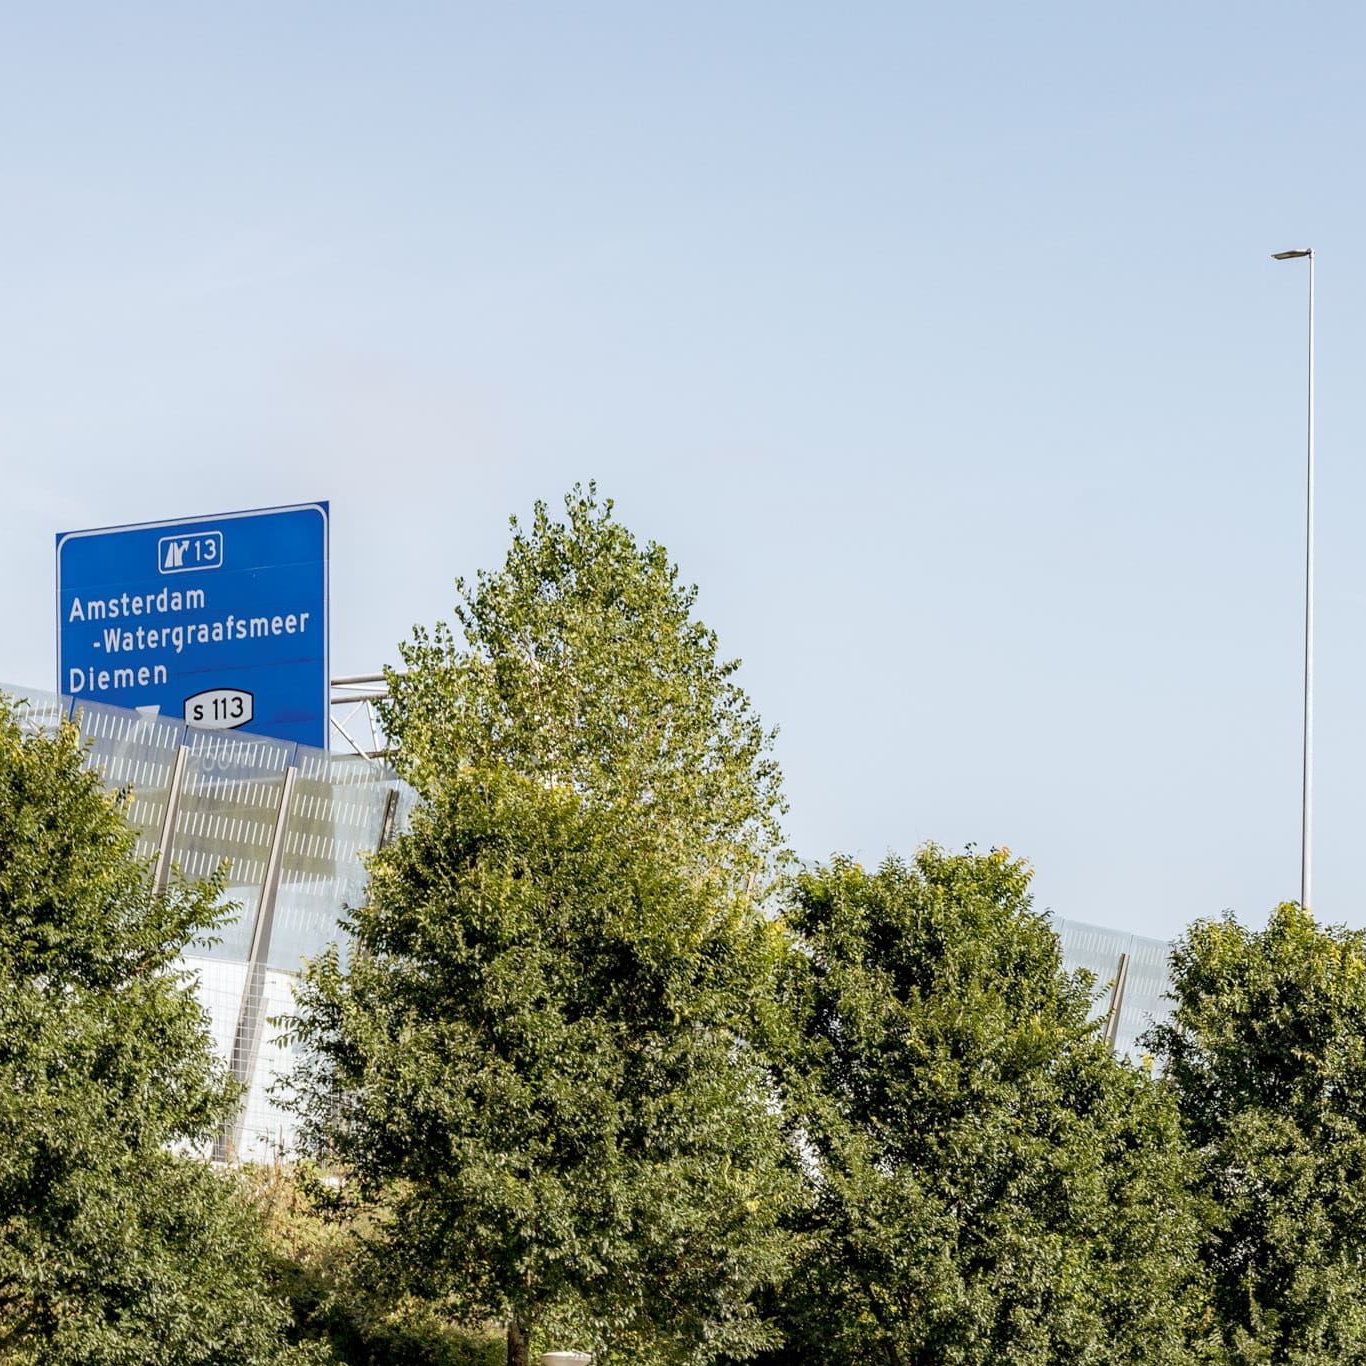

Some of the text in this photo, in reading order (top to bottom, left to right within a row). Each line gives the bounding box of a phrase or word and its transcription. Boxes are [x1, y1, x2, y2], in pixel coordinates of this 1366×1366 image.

[194, 539, 217, 562] 13
[68, 587, 205, 623] Amsterdam
[93, 613, 309, 654] -Watergraafsmeer
[69, 664, 168, 694] Diemen
[212, 697, 244, 720] 113
